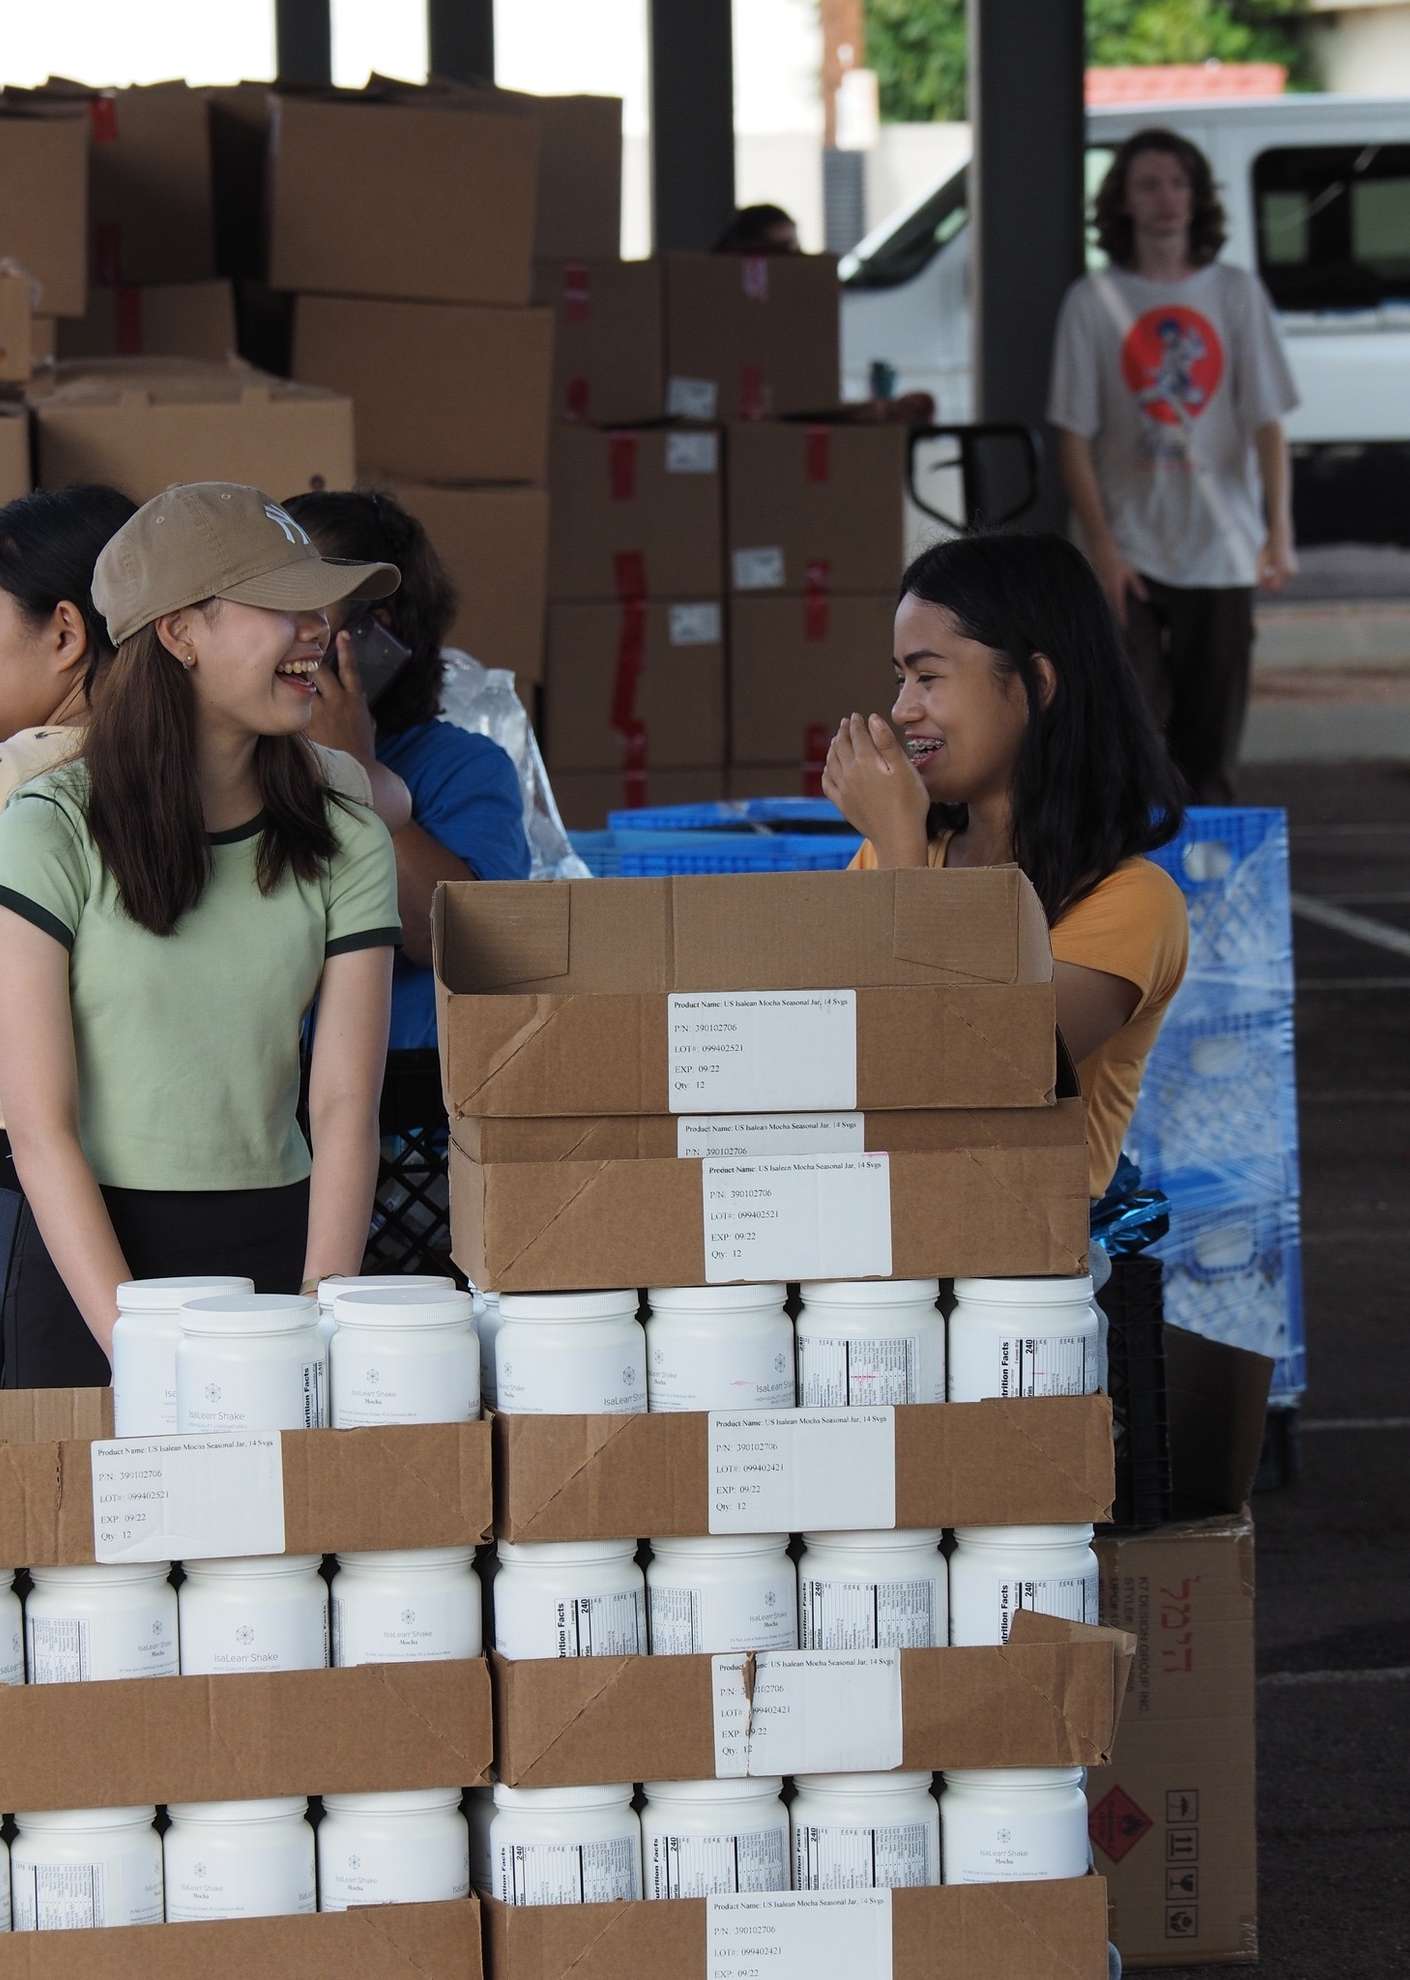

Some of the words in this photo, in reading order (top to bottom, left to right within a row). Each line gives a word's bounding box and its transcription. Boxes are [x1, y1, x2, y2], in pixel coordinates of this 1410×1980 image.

[674, 1001, 699, 1009] Product
[686, 1125, 710, 1133] Product
[709, 1167, 734, 1175] Product
[733, 1250, 742, 1258] 12
[716, 1420, 741, 1428] Product
[98, 1449, 123, 1457] Product
[206, 1442, 233, 1450] Seasonal
[123, 1531, 131, 1539] 12
[1024, 1582, 1032, 1597] 240
[557, 1603, 565, 1628] Facts
